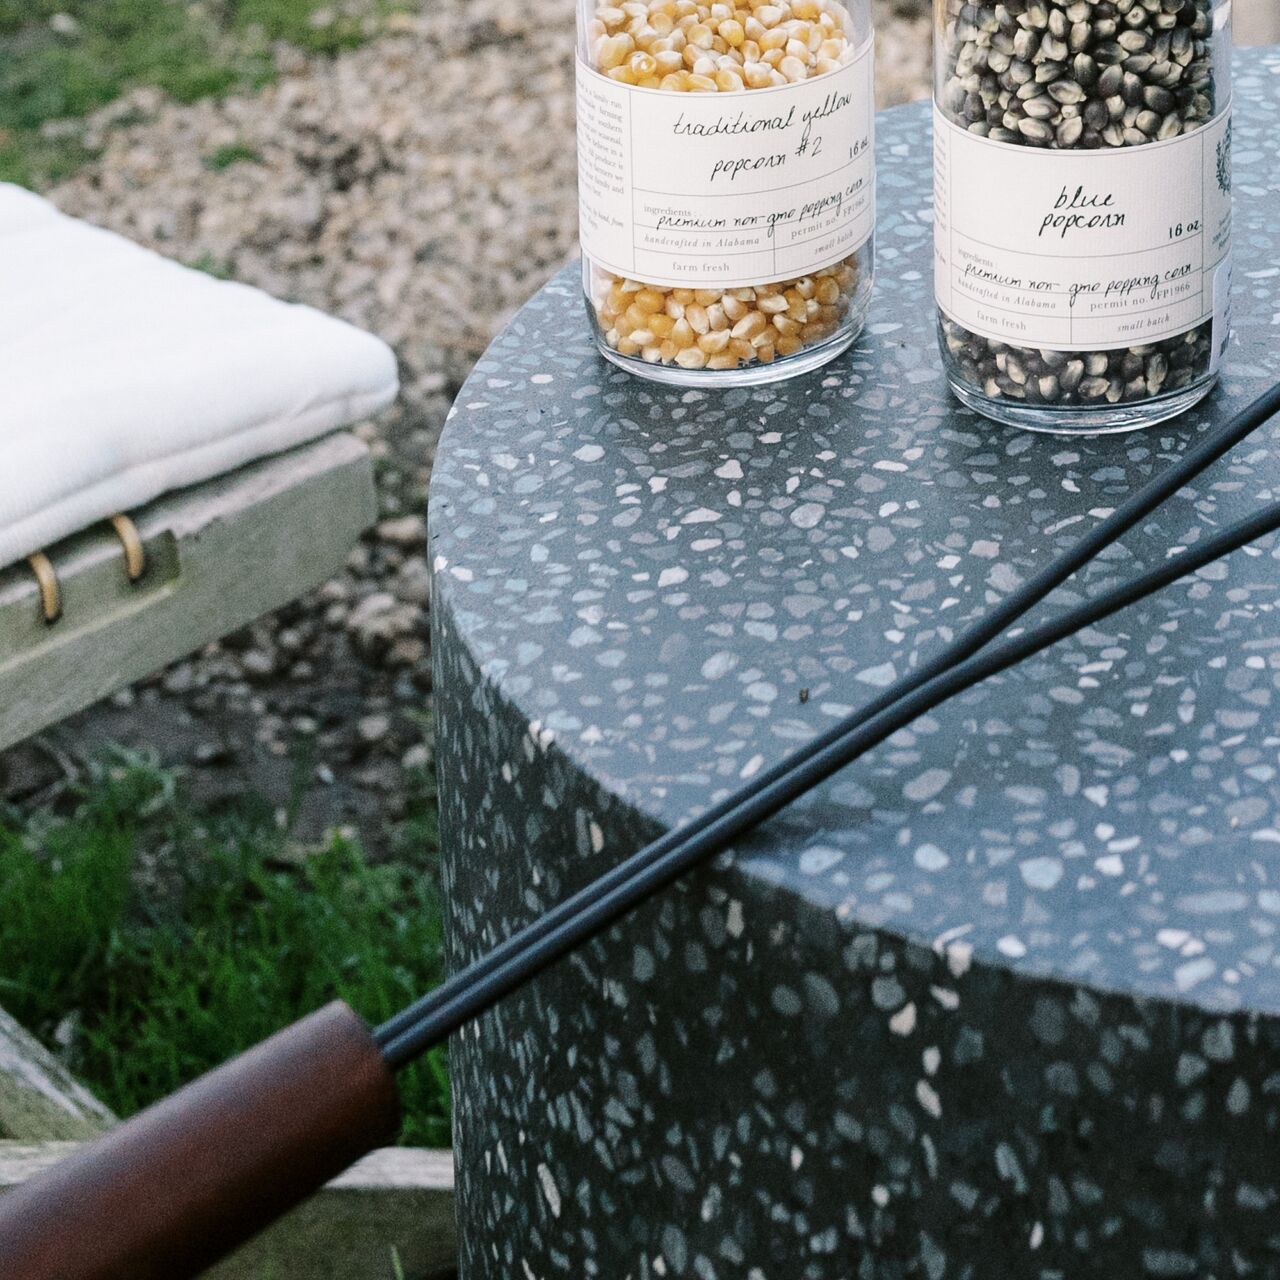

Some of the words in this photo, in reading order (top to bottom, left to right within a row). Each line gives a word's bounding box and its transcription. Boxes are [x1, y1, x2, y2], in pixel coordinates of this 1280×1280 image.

[673, 105, 795, 136] traditional
[801, 91, 851, 143] yellow
[849, 140, 859, 159] 16
[711, 153, 786, 181] popcorn
[1053, 185, 1115, 210] blue
[643, 203, 692, 217] ingredients
[656, 215, 726, 230] premium
[799, 191, 843, 223] popping
[791, 222, 822, 240] permit
[1038, 213, 1125, 238] popcorn
[1169, 223, 1183, 239] 16
[643, 234, 698, 248] handcrafted
[702, 238, 712, 247] in
[715, 237, 760, 247] Alabama
[672, 261, 698, 272] farm
[702, 262, 730, 272] fresh
[964, 263, 1022, 288] premium
[1104, 274, 1159, 300] popping
[1164, 263, 1191, 281] corn
[957, 277, 999, 300] handcrafted
[1001, 294, 1010, 303] in
[1013, 296, 1056, 309] Alabama
[1090, 299, 1127, 312] permit
[976, 310, 998, 325] farm
[1001, 317, 1026, 330] fresh
[1117, 320, 1143, 332] small
[1147, 313, 1169, 325] batch
